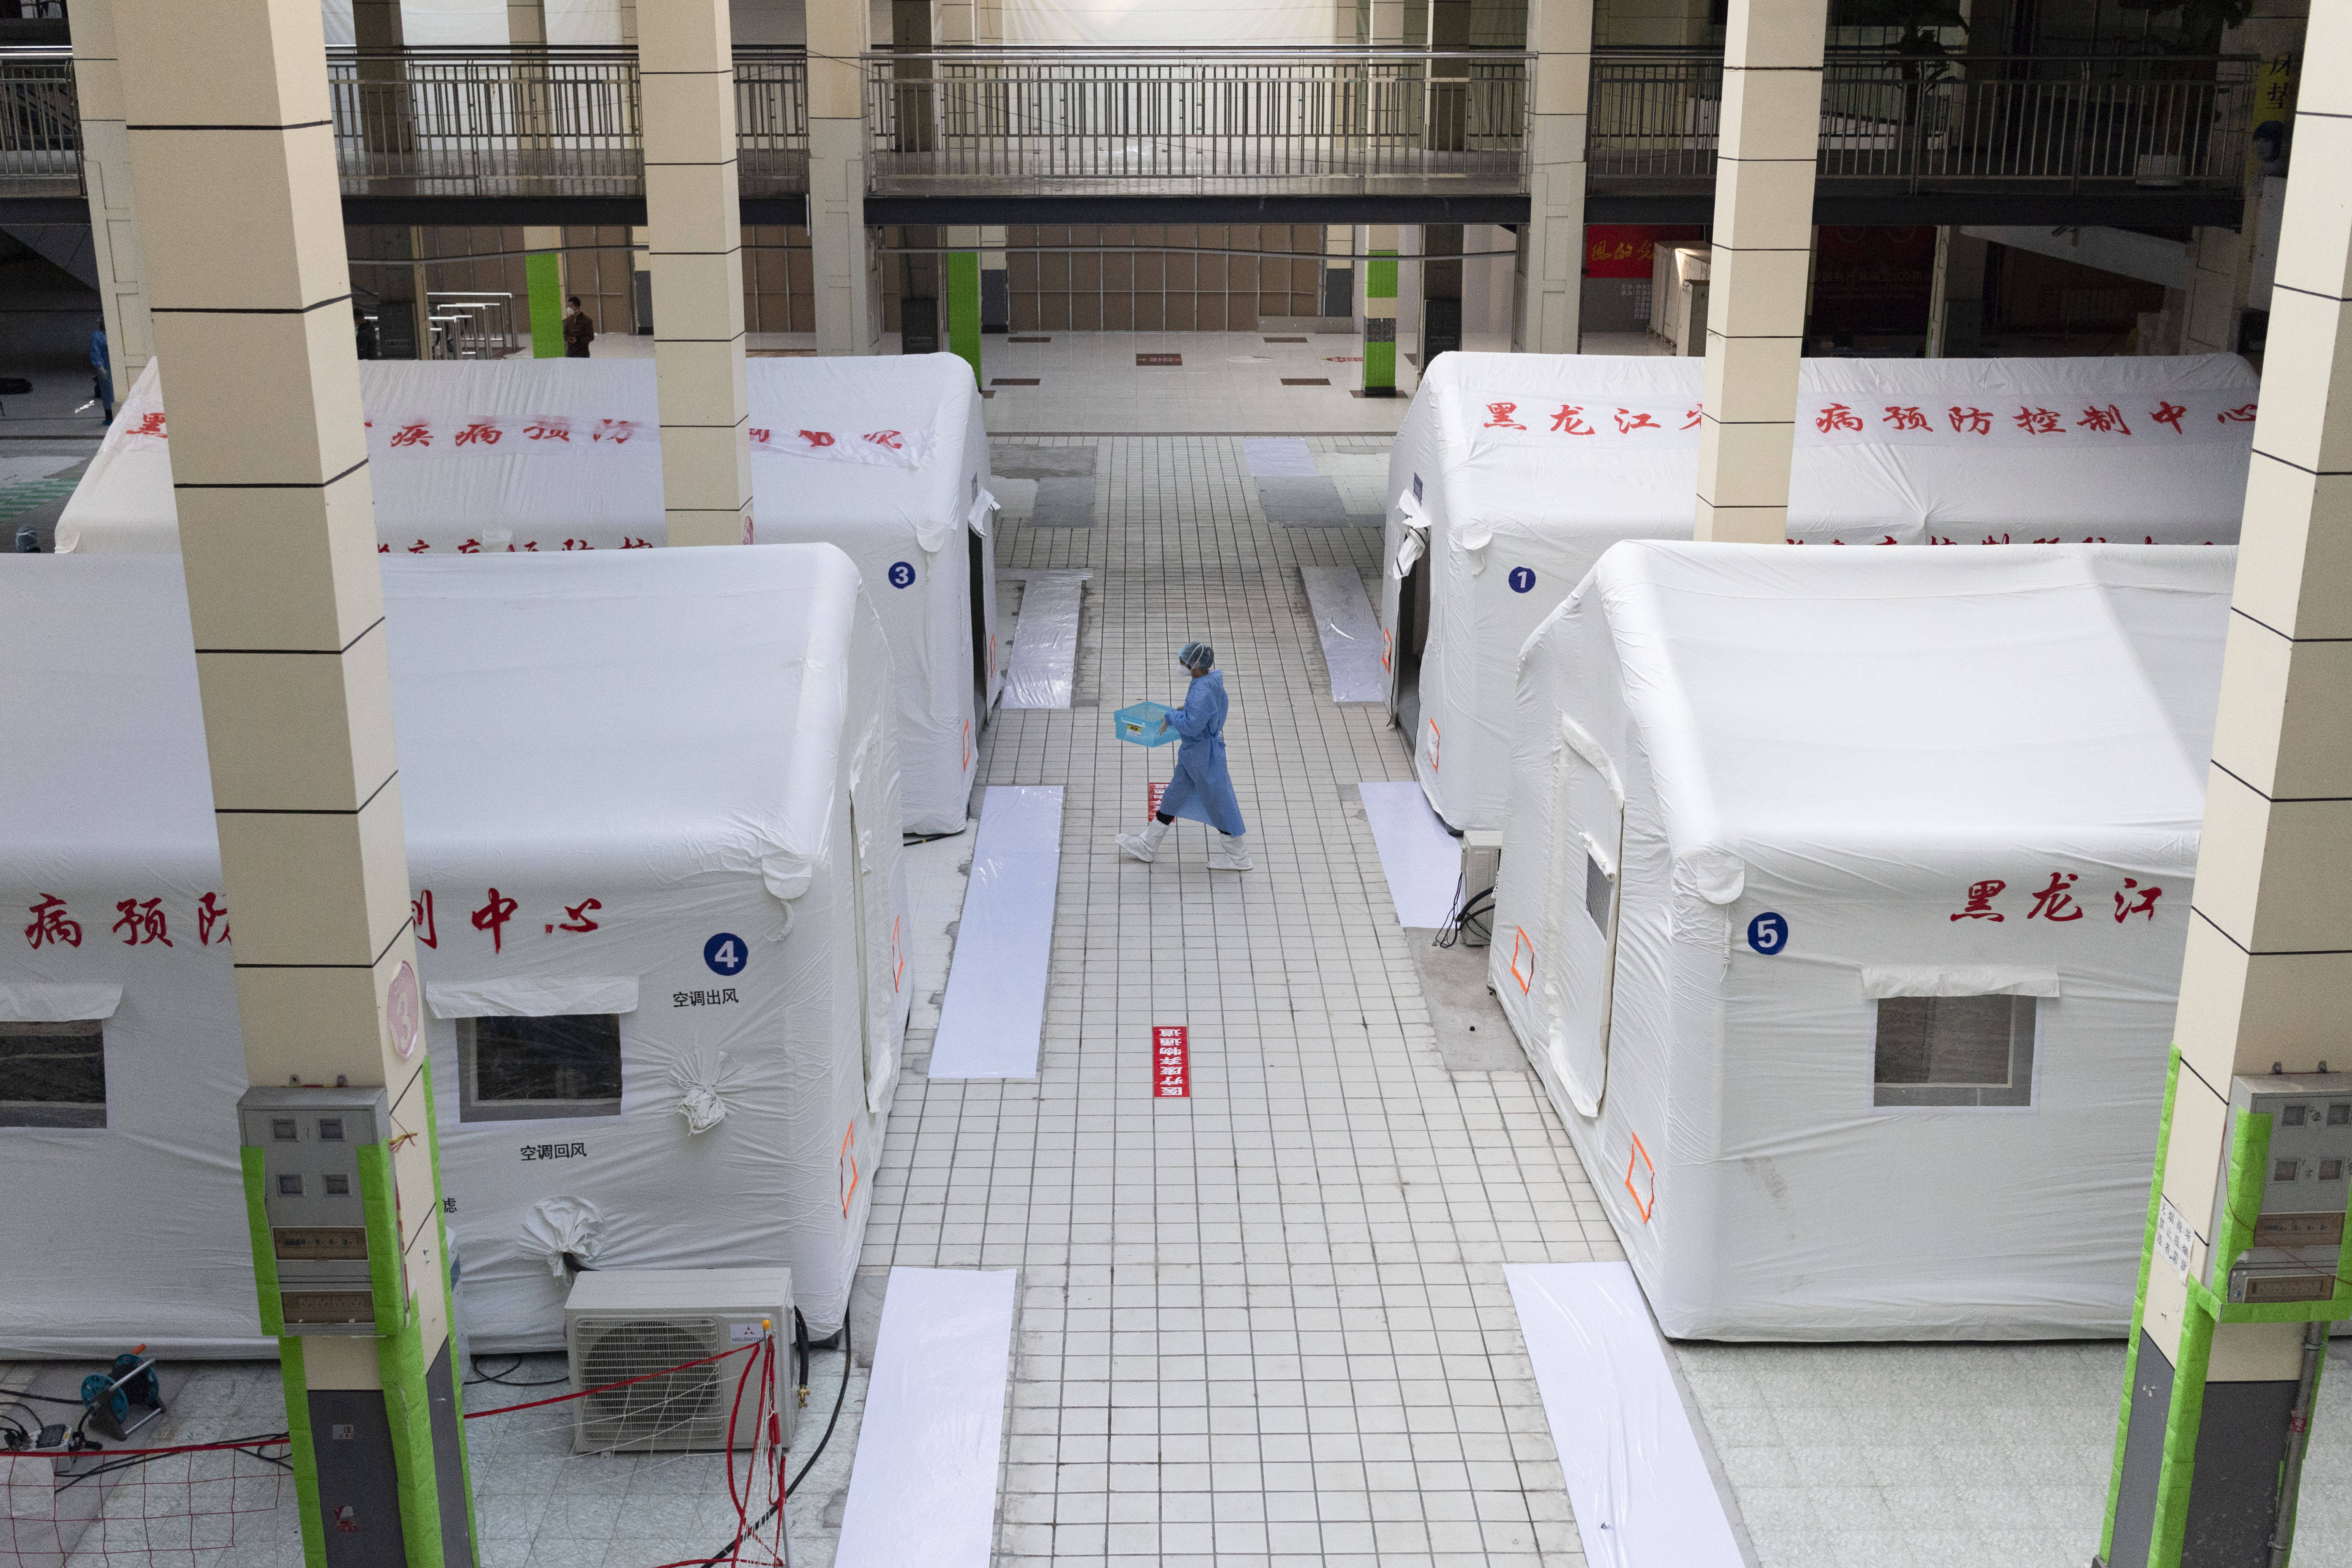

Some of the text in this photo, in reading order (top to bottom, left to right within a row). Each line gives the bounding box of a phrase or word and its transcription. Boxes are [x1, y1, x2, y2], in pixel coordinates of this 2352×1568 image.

[895, 566, 908, 584] 3
[1518, 571, 1527, 588] 1
[1950, 872, 2162, 923] 黑龙江
[1758, 919, 1778, 947] 5
[715, 941, 738, 967] 4
[673, 988, 739, 1007] 空调出风
[1159, 1029, 1183, 1096] 医疗废弃物通道
[520, 1143, 587, 1161] 空调回风
